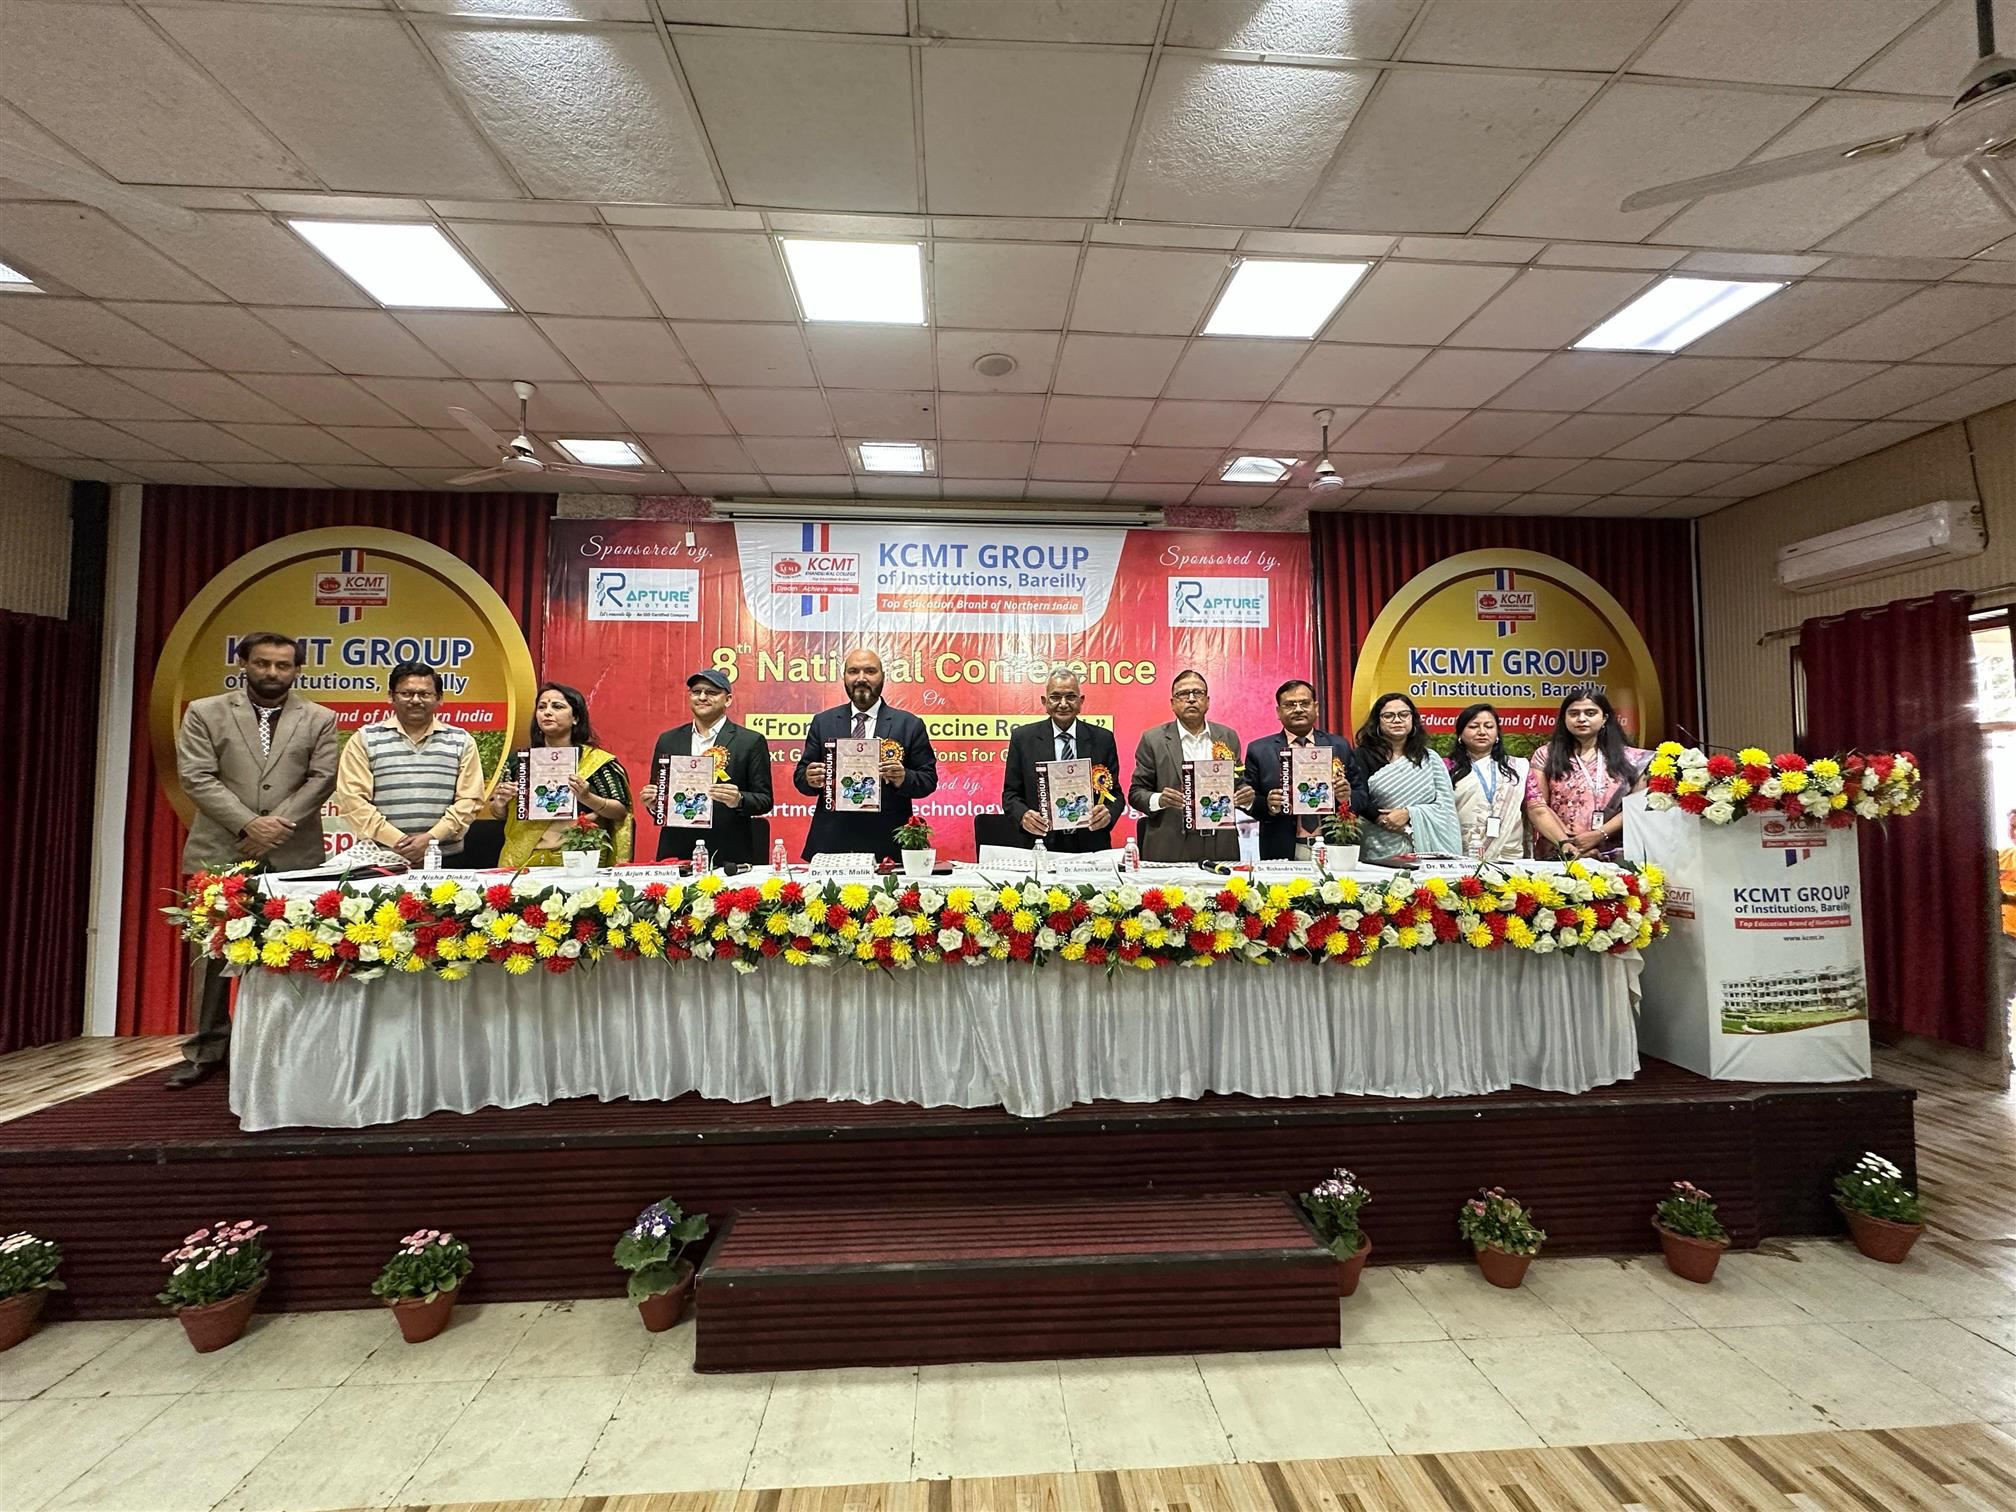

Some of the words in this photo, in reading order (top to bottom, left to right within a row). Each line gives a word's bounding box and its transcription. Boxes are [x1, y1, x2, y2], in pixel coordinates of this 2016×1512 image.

[581, 535, 682, 561] Sponsored
[879, 542, 968, 568] KCMT
[978, 544, 1089, 570] GROUP
[1159, 545, 1252, 570] Sponsored
[807, 557, 855, 571] KCMT
[345, 576, 385, 588] KCMT
[877, 570, 896, 585] of
[901, 571, 1012, 589] Institutions,
[1018, 572, 1086, 592] Bareilly
[881, 598, 900, 609] Top
[902, 599, 954, 610] Education
[956, 599, 987, 610] Brand
[990, 600, 1002, 611] of
[1003, 600, 1049, 611] Northern
[1051, 601, 1079, 611] India
[1500, 593, 1532, 604] KCMT
[227, 637, 332, 666] KT
[342, 638, 472, 667] GROUP
[1410, 649, 1494, 675] KCMT
[1502, 649, 1607, 675] GROUP
[757, 648, 926, 684] Natial
[293, 672, 381, 692] itutions,
[1410, 680, 1428, 696] of
[1432, 681, 1536, 698] Institutions,
[922, 689, 946, 706] On
[363, 709, 380, 725] of
[455, 709, 494, 722] India
[926, 717, 989, 737] ccine
[1419, 713, 1460, 726] Educa
[1522, 714, 1537, 729] of
[971, 747, 996, 762] for
[518, 762, 527, 820] COMPENDIUM
[825, 753, 833, 810] COMPENDIUM
[656, 768, 667, 825] COMPENDIUM
[1038, 777, 1050, 820] MPENDIUM
[1184, 774, 1193, 829] COMPENDIUM
[1667, 889, 1691, 901] CMT
[1733, 887, 1792, 903] KCMT
[1797, 885, 1850, 902] GROUP
[1735, 904, 1749, 914] of
[1751, 903, 1818, 914] Institutions,
[1739, 920, 1753, 928] Top
[1754, 920, 1788, 928] Education
